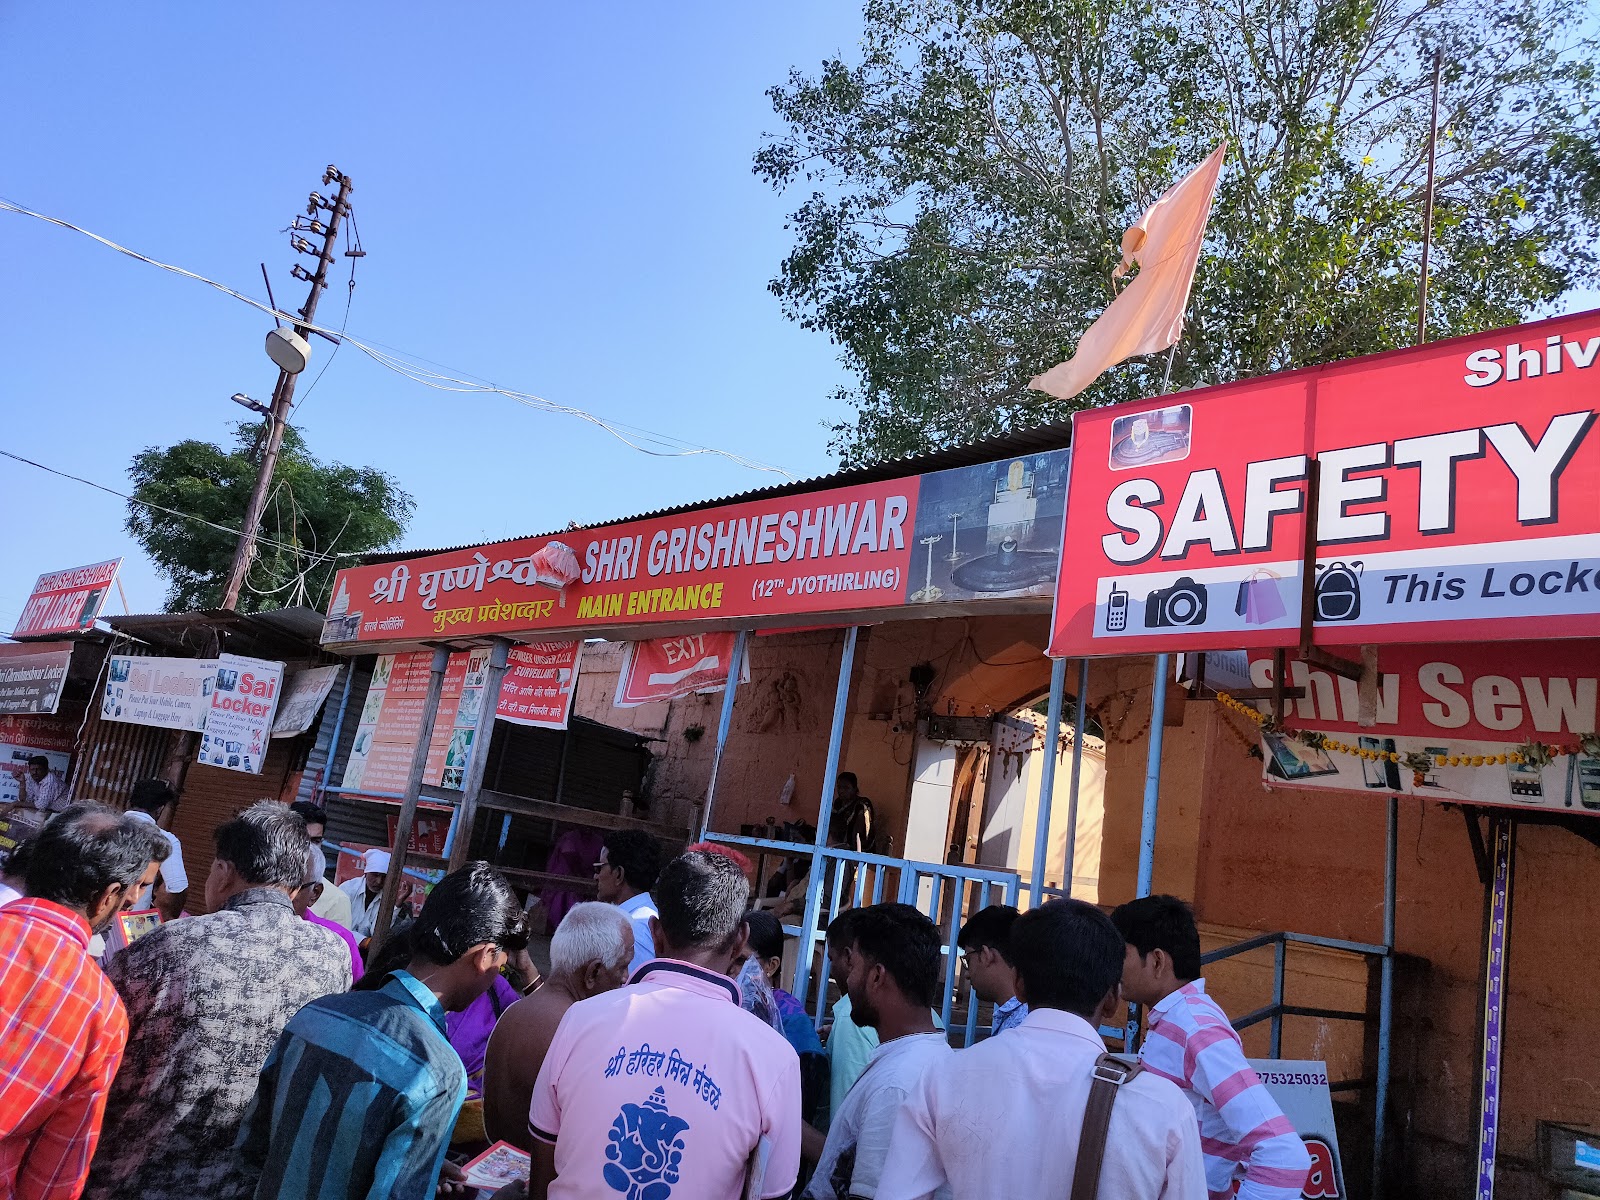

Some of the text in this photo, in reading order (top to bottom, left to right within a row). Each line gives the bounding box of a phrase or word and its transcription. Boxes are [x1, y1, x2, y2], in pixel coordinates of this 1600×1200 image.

[1464, 334, 1600, 388] Shiv
[1101, 409, 1600, 565] SAFETY
[581, 495, 909, 585] SHRI GRISHNESHWAR
[369, 551, 537, 610] श्री घृष्णेश्व
[751, 567, 899, 600] (12TH JYOTHIRLING)
[1384, 562, 1600, 604] This Lock
[576, 582, 724, 619] MAIN ENTRANCE
[433, 607, 475, 633] मुख्य
[662, 632, 707, 665] EXIT
[128, 694, 141, 703] Please
[141, 696, 149, 704] Put
[129, 668, 203, 697] Sai Locker
[239, 672, 277, 699] Sai
[210, 710, 225, 718] Please
[211, 691, 271, 717] Locker
[604, 1046, 626, 1078] श्री
